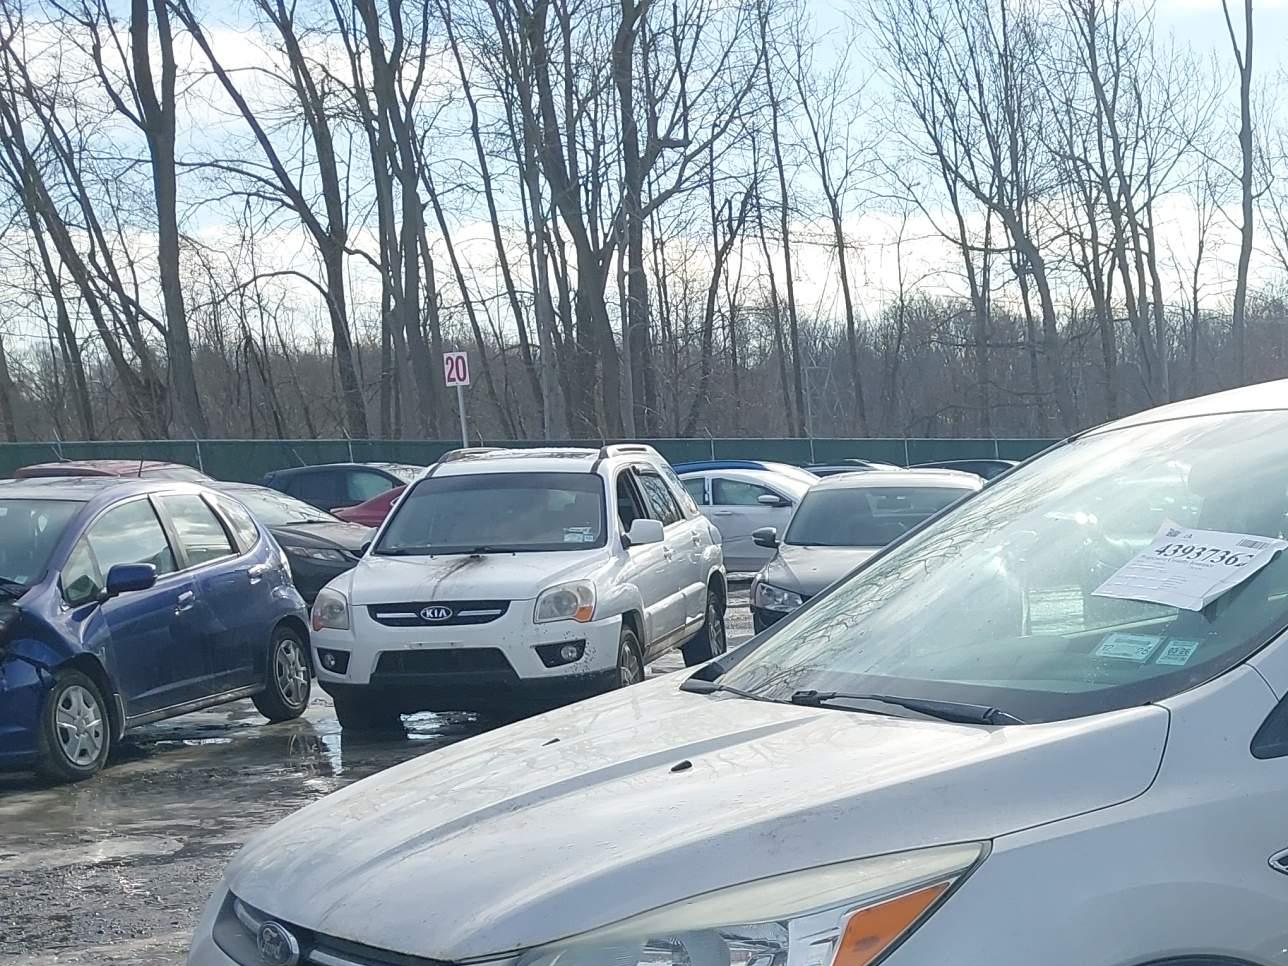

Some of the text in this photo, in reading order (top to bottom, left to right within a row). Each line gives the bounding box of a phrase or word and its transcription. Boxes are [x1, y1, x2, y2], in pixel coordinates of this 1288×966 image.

[446, 355, 467, 382] 20
[1155, 543, 1255, 567] 43937362
[426, 609, 447, 618] KIA
